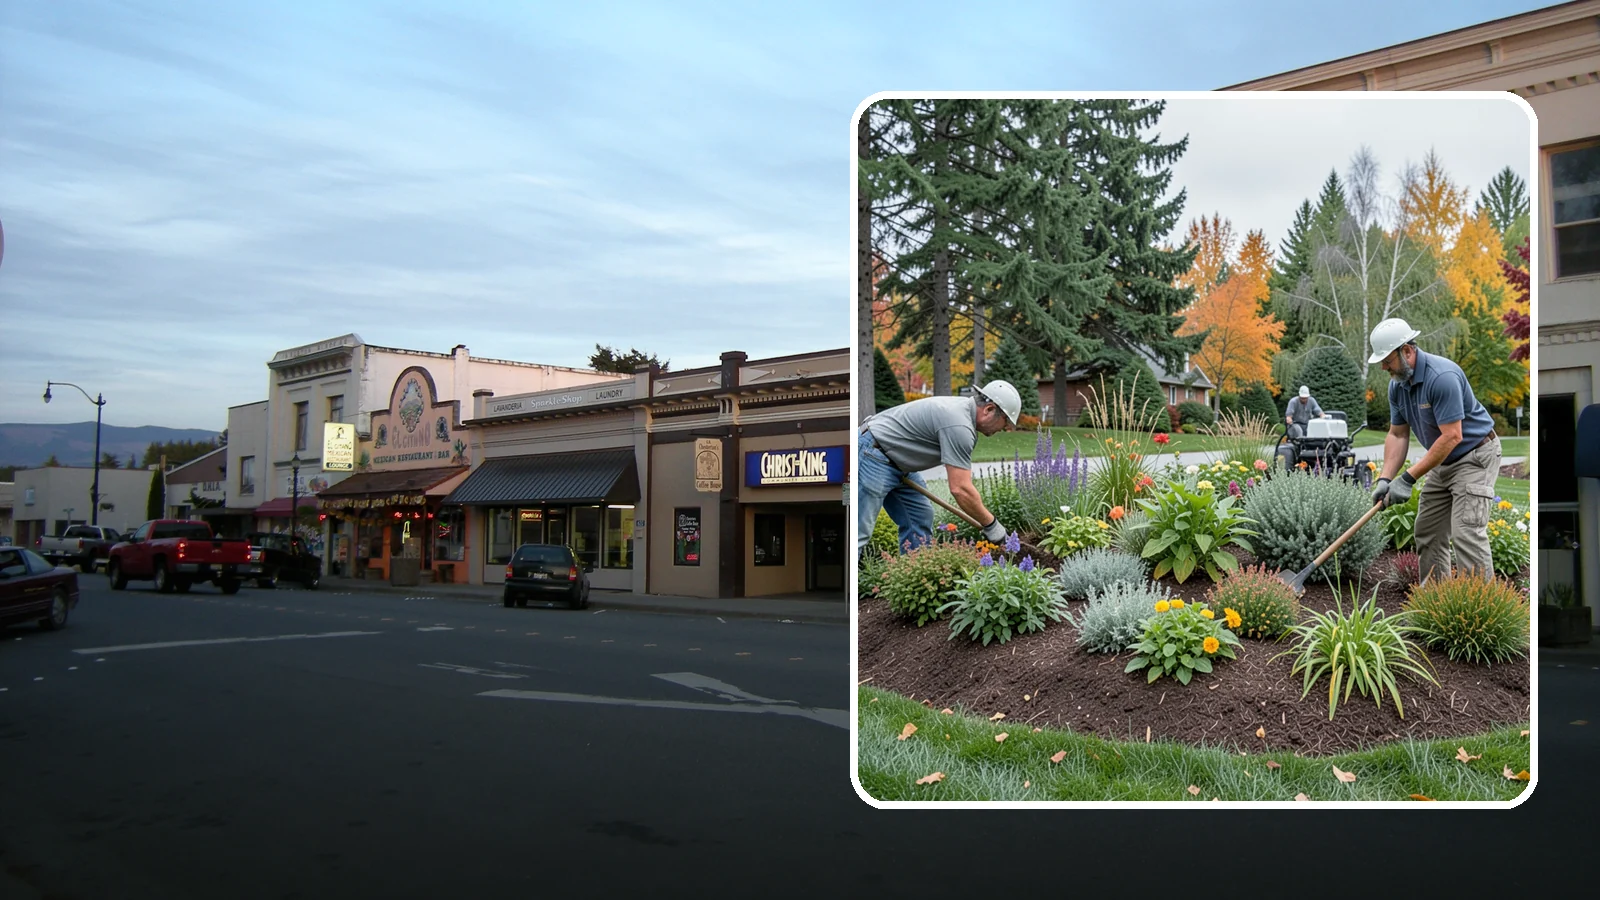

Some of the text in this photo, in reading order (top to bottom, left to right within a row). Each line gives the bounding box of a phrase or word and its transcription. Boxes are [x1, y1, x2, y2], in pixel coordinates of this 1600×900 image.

[562, 394, 582, 405] Shop
[595, 389, 623, 400] LAUNDRY
[373, 455, 396, 464] MEXICAN
[397, 452, 433, 462] RESTAURANT
[438, 450, 450, 459] BAR
[761, 450, 827, 477] CHRIST KING
[696, 481, 709, 489] Coffee
